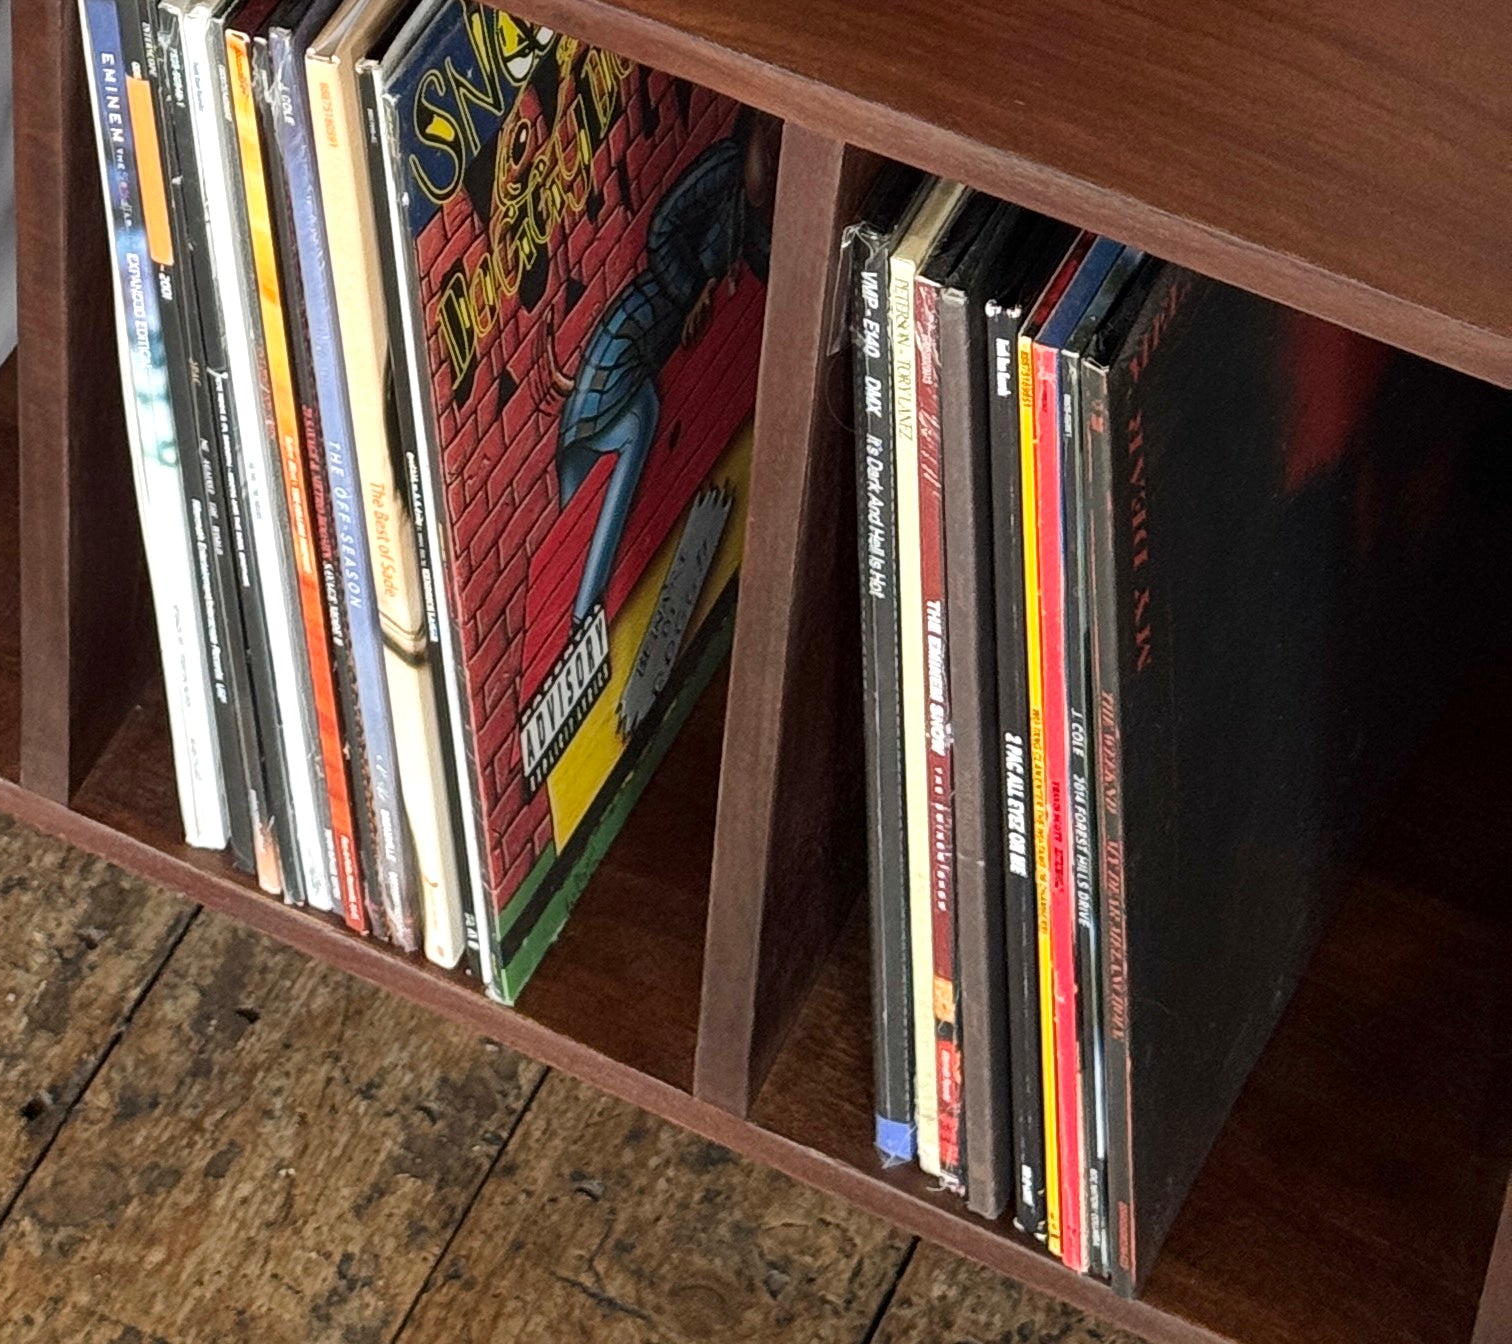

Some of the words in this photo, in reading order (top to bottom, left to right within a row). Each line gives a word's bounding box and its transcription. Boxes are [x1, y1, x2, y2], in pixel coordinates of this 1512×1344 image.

[102, 52, 123, 142] EMINEM
[280, 94, 295, 125] COLE
[127, 253, 145, 317] EXPANDED
[159, 273, 170, 300] 2001
[896, 277, 909, 346] PETERSON
[898, 359, 910, 396] TORY
[866, 376, 881, 417] DMX
[898, 396, 911, 440] LANEZ
[868, 433, 882, 456] It's
[868, 456, 883, 493] Dark
[372, 482, 386, 508] The
[869, 493, 883, 525] And
[328, 441, 344, 476] THE
[336, 487, 365, 608] OFF-SEASON
[375, 510, 390, 542] Best
[870, 526, 884, 555] Hell
[380, 544, 393, 561] of
[871, 555, 884, 569] Is
[383, 562, 398, 597] Sade
[870, 569, 885, 598] Hot
[927, 600, 940, 634] THE
[928, 634, 944, 702] EMINEM
[526, 616, 605, 767] ADVISORY
[930, 703, 944, 755] SHOW
[1071, 722, 1083, 757] COLE
[1006, 744, 1022, 773] PAC
[1007, 772, 1023, 797] ALL
[1073, 774, 1085, 804] 2014
[1007, 798, 1024, 832] EYEZ
[1074, 804, 1086, 852] FOREST
[1009, 832, 1024, 852] ON
[1010, 853, 1026, 877] ME
[1076, 855, 1087, 888] HILLS
[1077, 890, 1088, 927] DRIVE
